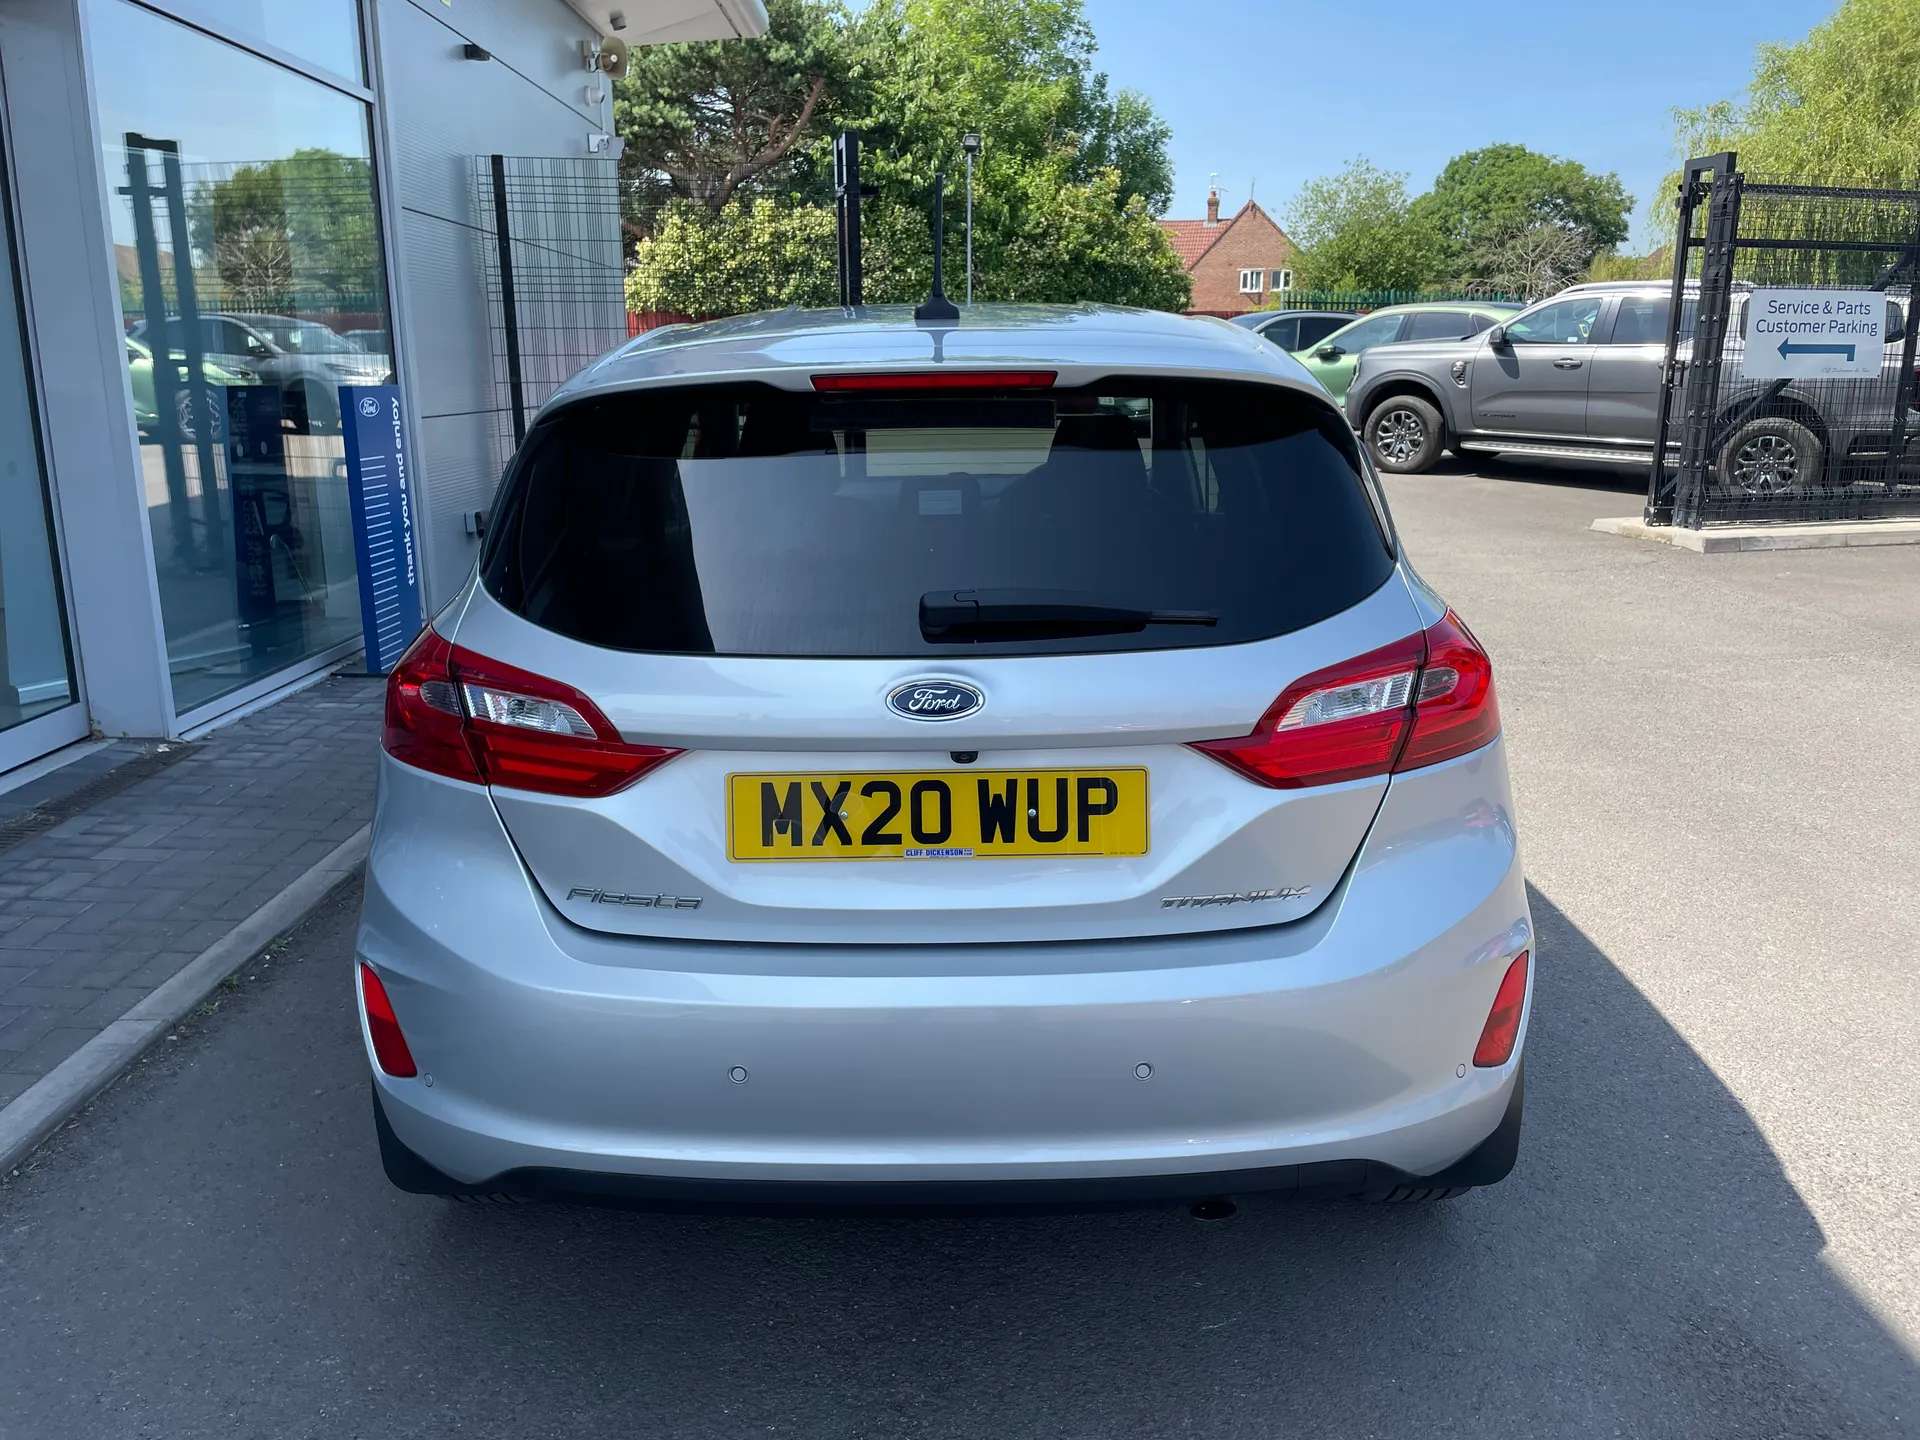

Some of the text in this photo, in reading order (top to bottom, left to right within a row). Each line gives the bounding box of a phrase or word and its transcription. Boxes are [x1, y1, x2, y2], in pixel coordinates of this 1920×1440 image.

[1767, 300, 1871, 315] Service & Parts
[1756, 319, 1878, 336] Customer Parking
[391, 397, 415, 586] thank you and enjoy
[908, 688, 961, 711] Ford
[760, 776, 1119, 847] MX20 WUP
[905, 848, 924, 857] CLIFF
[926, 848, 963, 857] DICKENSON
[566, 887, 703, 910] Fiesta
